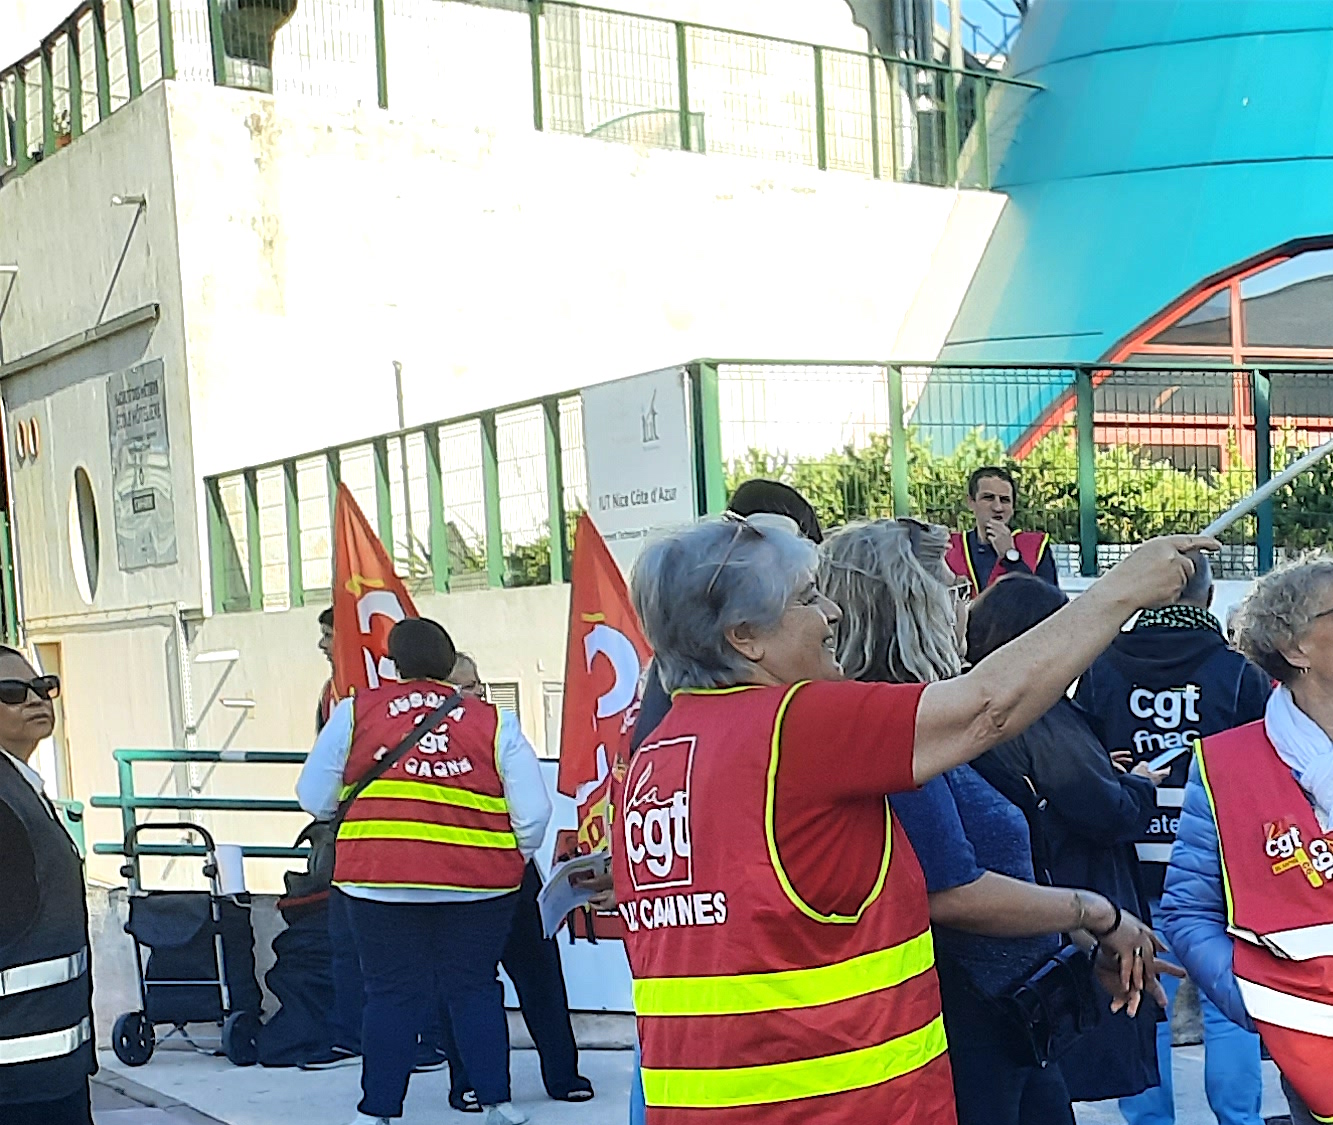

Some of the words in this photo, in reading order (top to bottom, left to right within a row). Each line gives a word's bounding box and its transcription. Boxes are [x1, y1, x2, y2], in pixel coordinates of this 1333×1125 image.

[612, 493, 629, 508] Nice
[630, 488, 649, 506] Côte
[651, 486, 677, 504] d'Azur
[1130, 684, 1200, 729] cgt
[1133, 730, 1200, 753] fnac
[626, 761, 675, 812] la
[626, 791, 690, 877] cgt
[1266, 826, 1303, 858] cgt
[640, 892, 727, 930] CANNES
